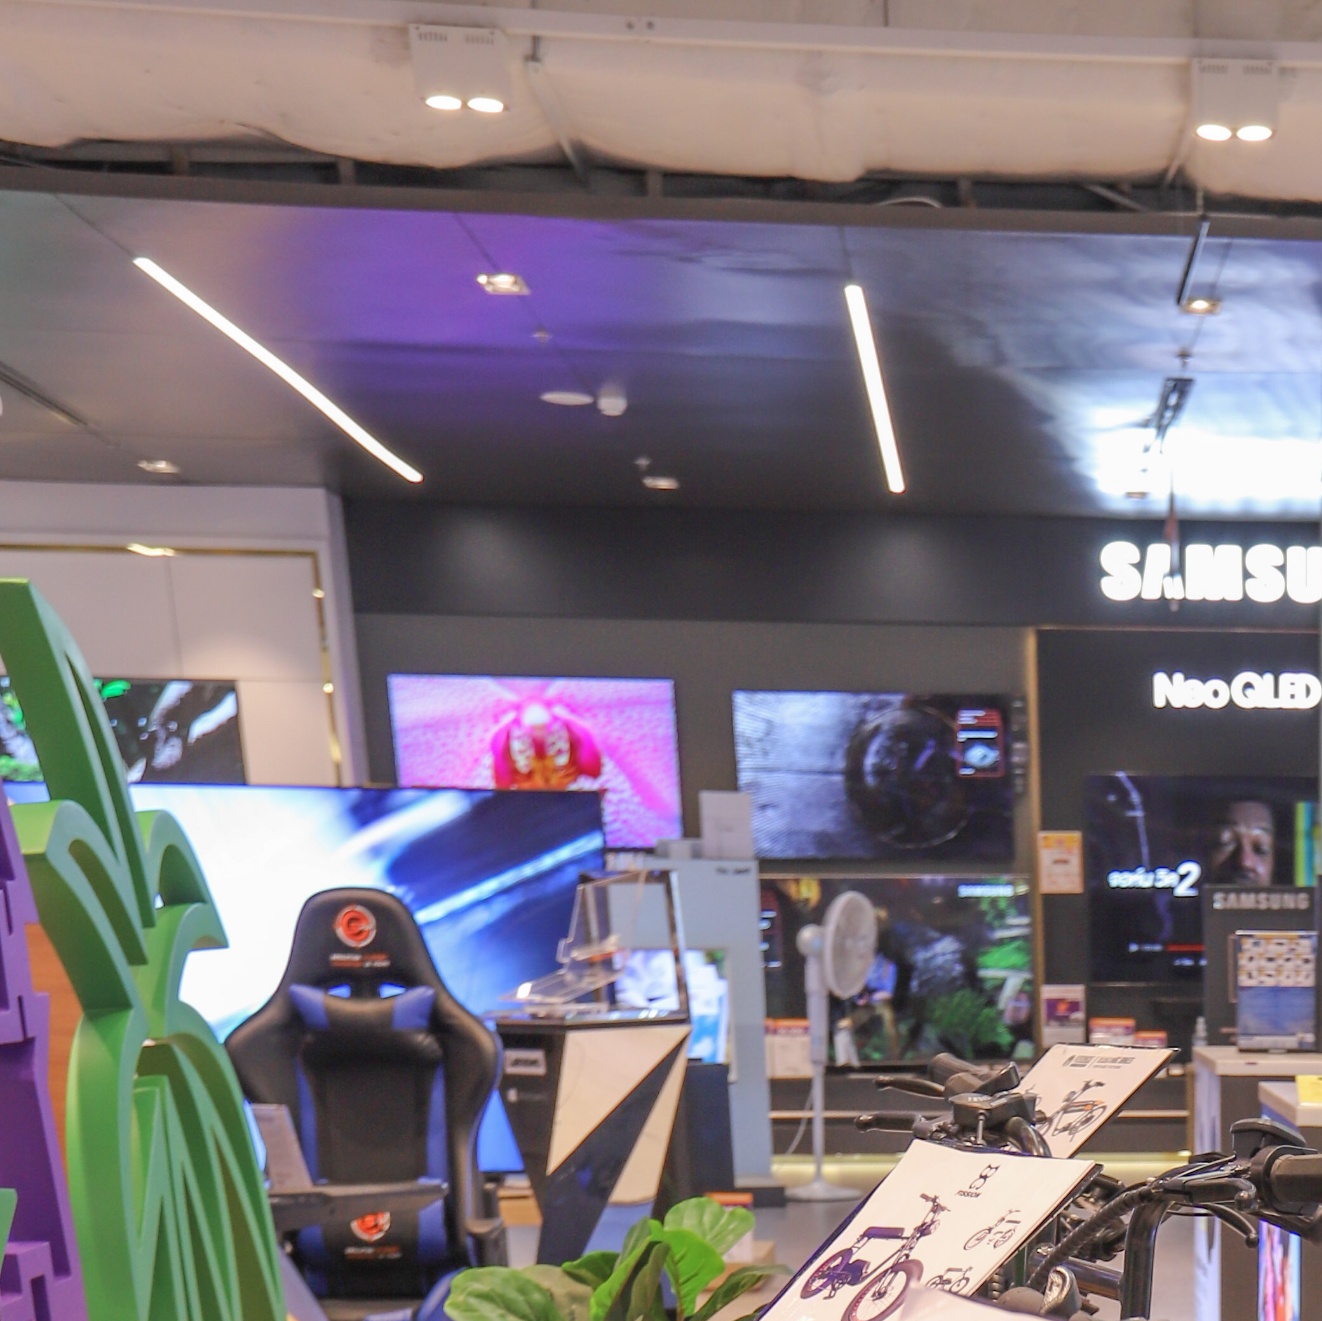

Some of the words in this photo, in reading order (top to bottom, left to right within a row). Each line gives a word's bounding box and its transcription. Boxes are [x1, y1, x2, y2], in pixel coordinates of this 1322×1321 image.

[1153, 671, 1231, 709] Neo
[1230, 671, 1322, 709] QLED
[1213, 892, 1310, 910] SAMSUNG
